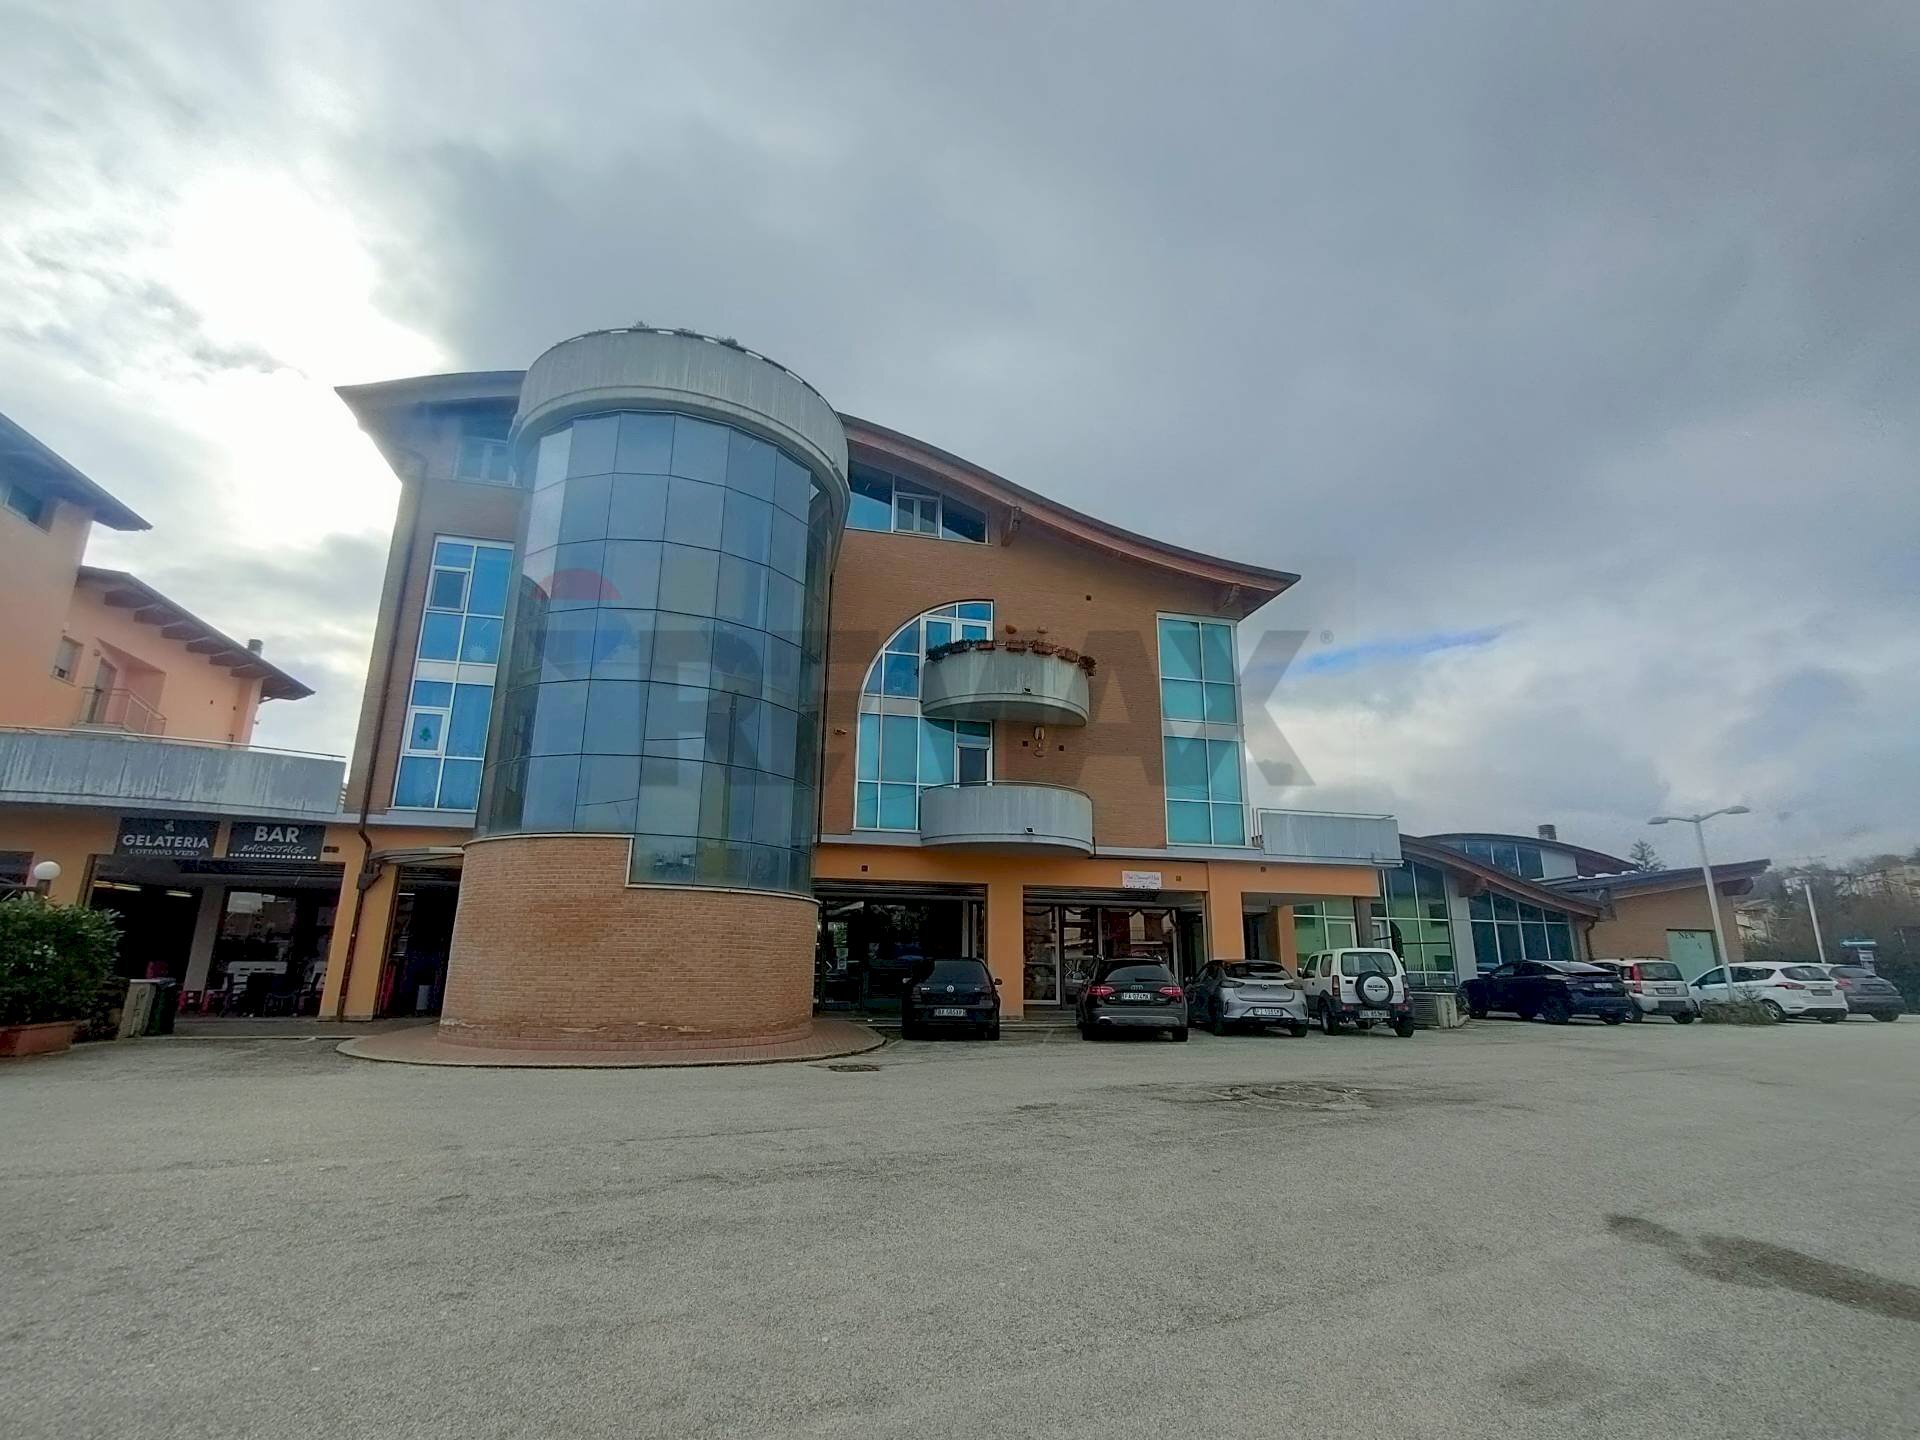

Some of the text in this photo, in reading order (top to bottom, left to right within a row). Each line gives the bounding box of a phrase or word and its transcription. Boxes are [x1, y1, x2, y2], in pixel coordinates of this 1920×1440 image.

[122, 834, 209, 849] GELATERIA
[254, 826, 300, 843] BAR
[240, 843, 308, 854] BACKSTAGE
